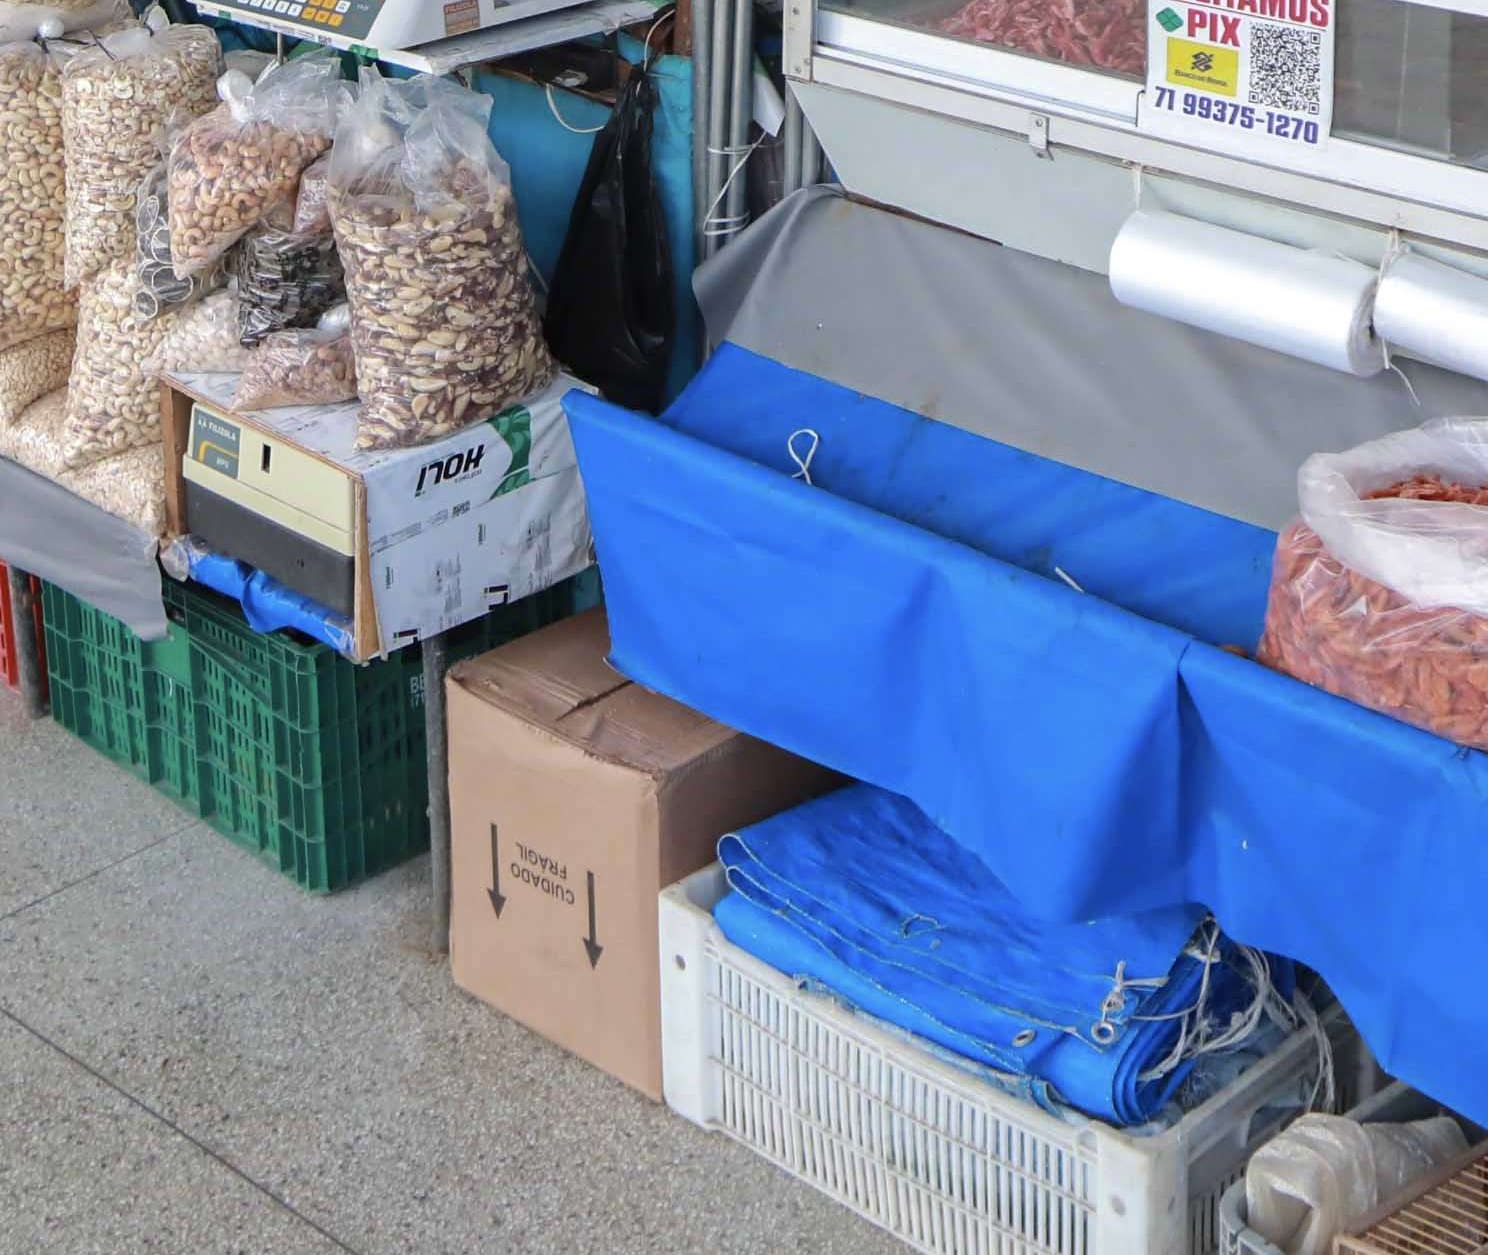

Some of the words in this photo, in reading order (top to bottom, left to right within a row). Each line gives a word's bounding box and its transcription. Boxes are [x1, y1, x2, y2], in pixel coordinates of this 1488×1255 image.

[1187, 7, 1242, 48] PIX
[1154, 85, 1176, 111] 71
[1182, 92, 1320, 145] 99375-1270
[510, 862, 575, 905] CUIDADO
